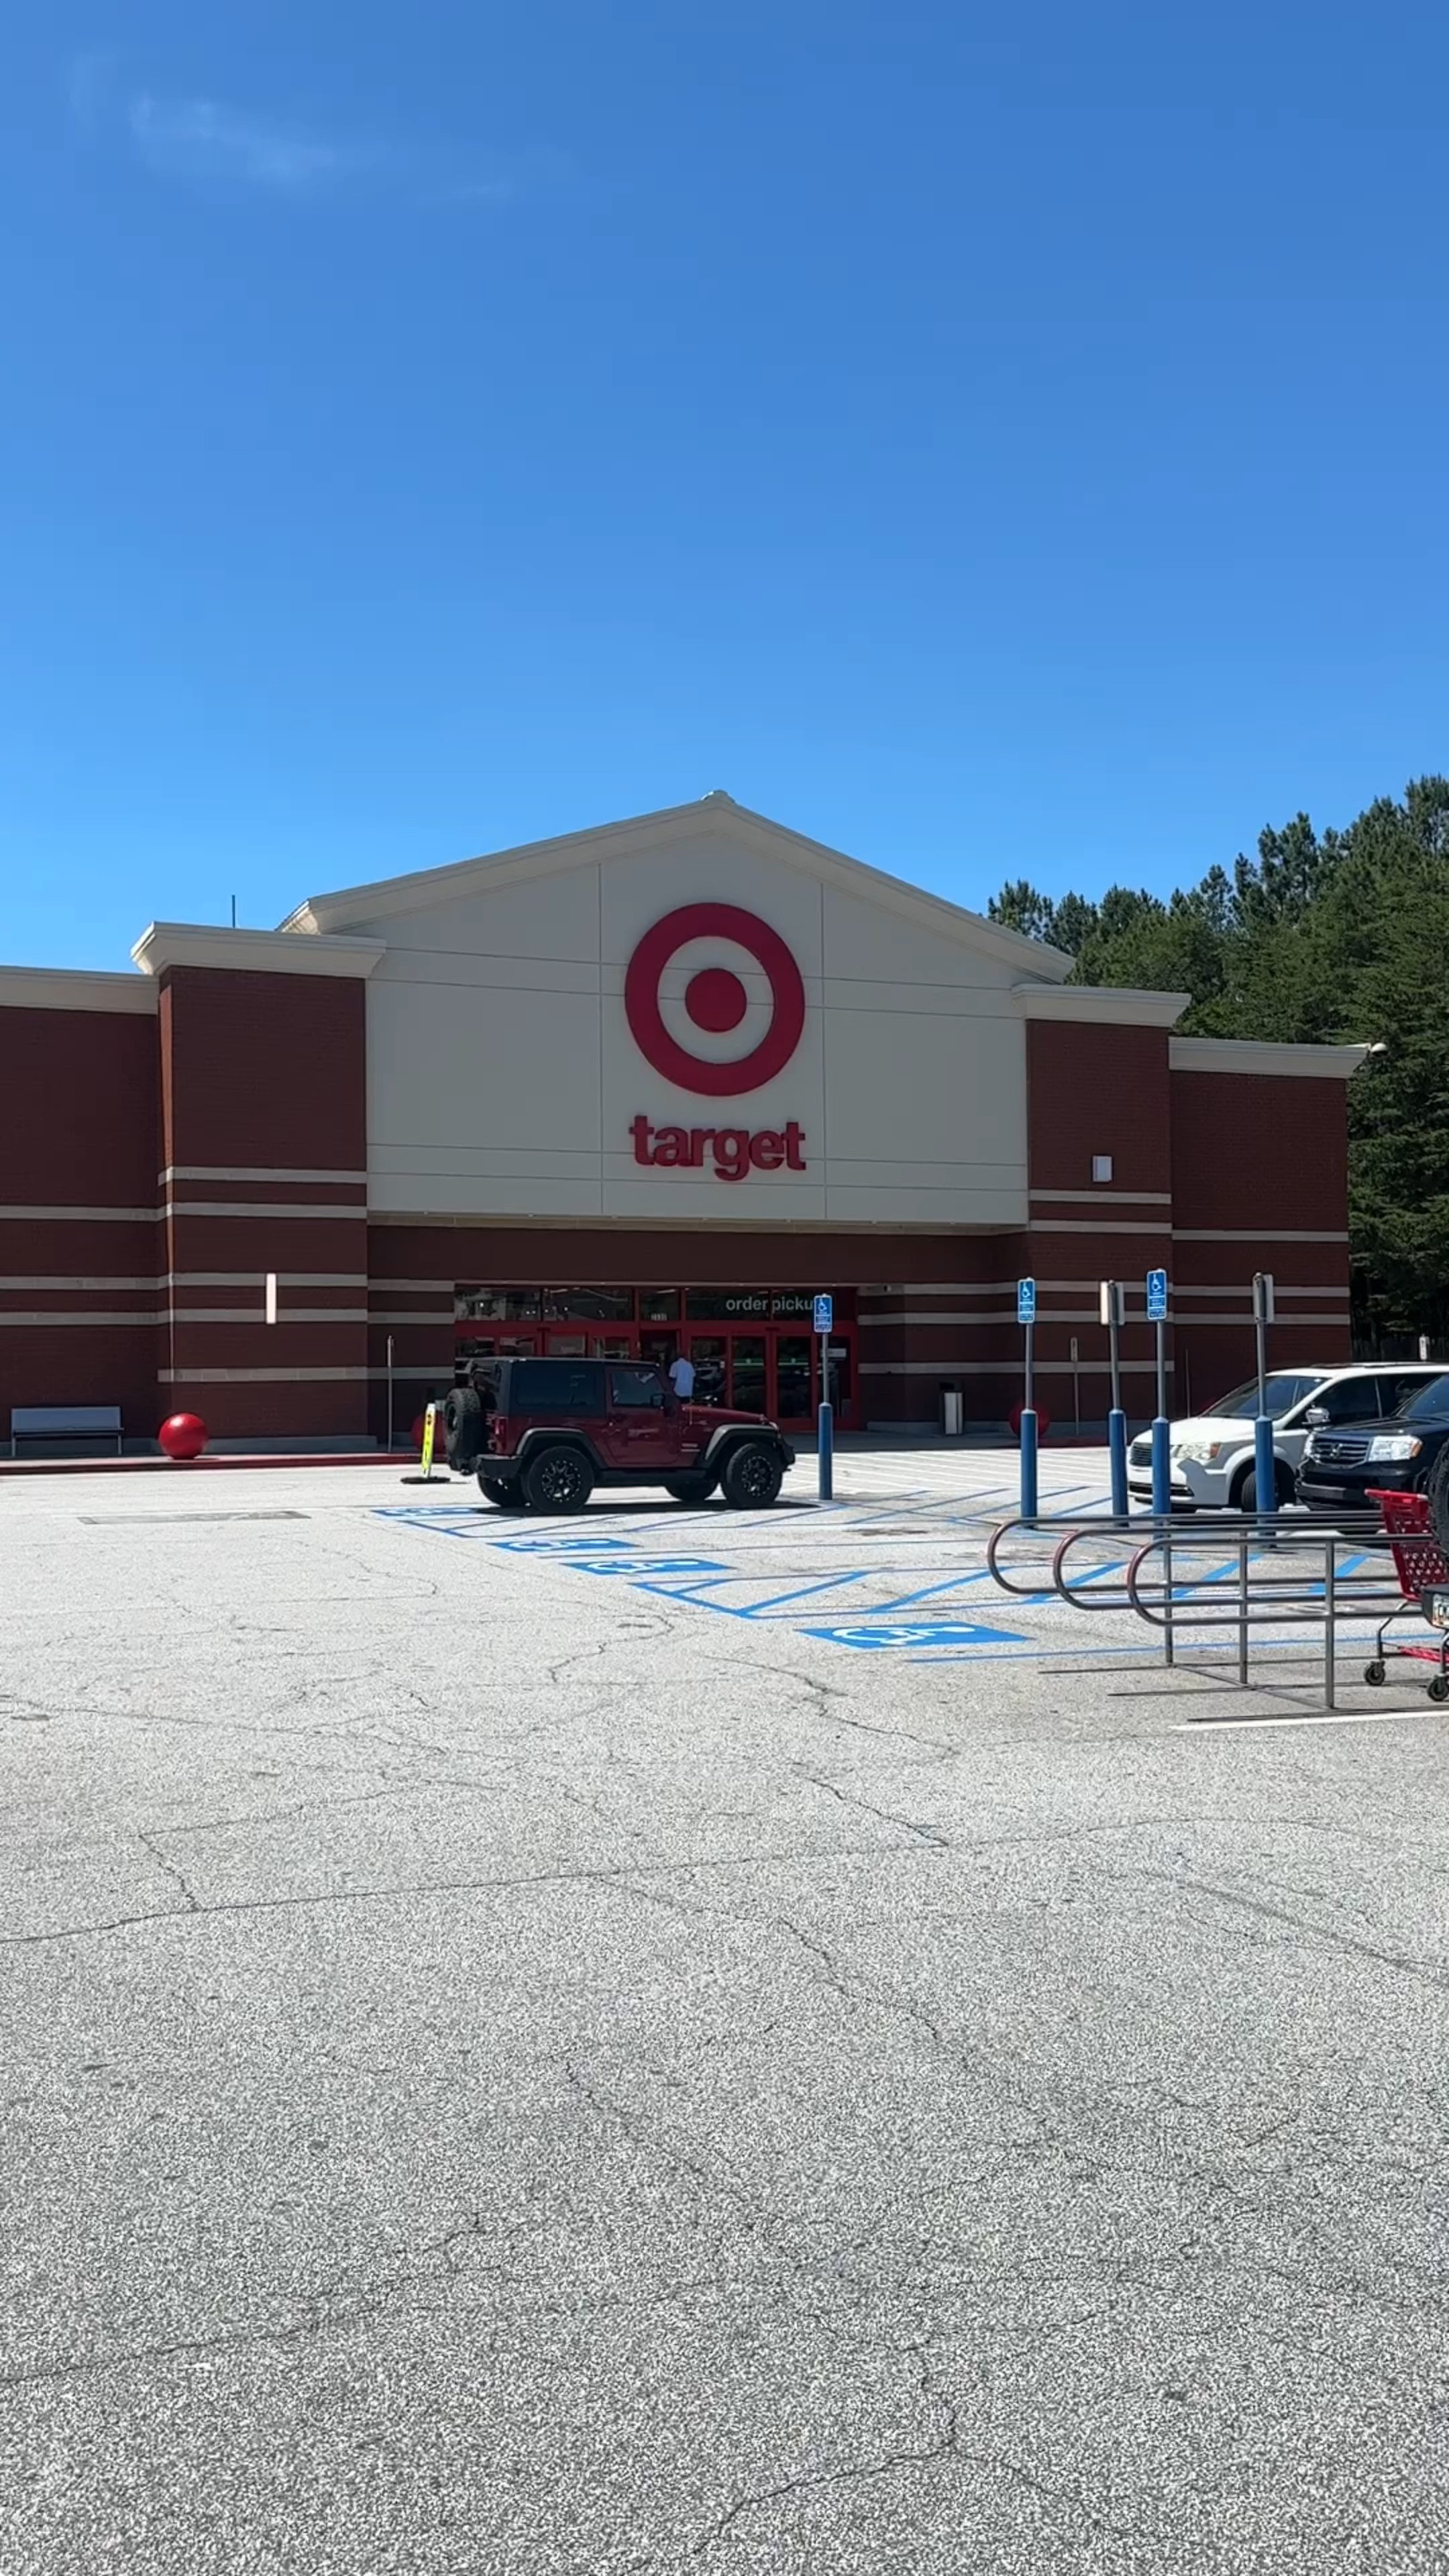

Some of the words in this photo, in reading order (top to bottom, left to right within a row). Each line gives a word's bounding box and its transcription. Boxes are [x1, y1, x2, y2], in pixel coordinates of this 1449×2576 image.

[629, 1115, 806, 1181] target
[725, 1296, 769, 1311] order
[772, 1296, 814, 1314] picku
